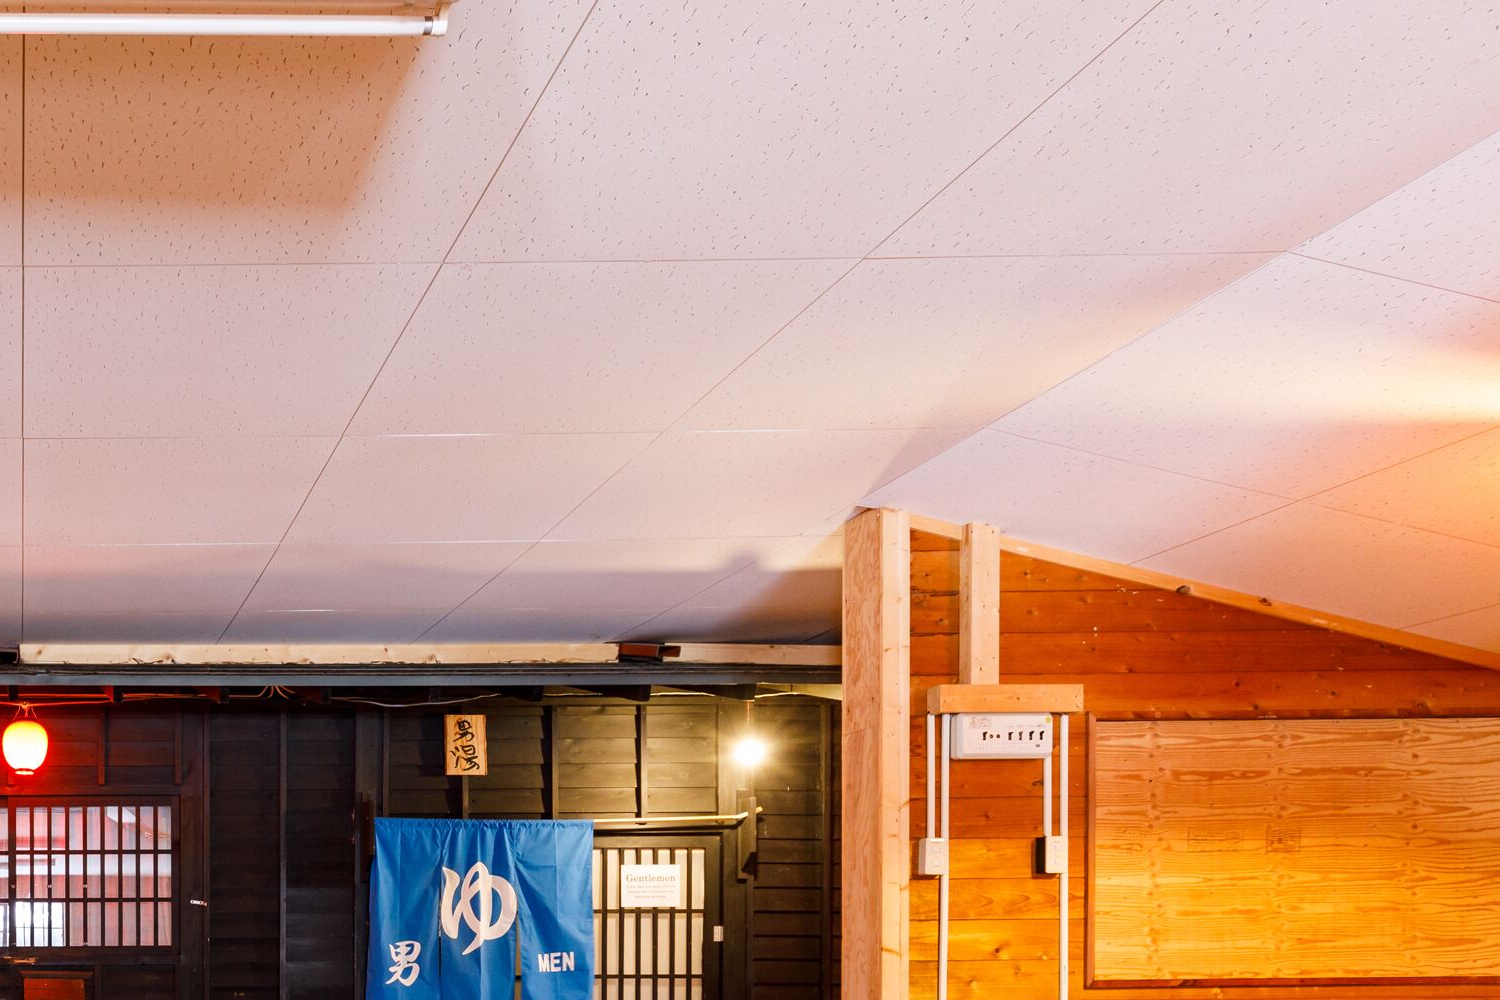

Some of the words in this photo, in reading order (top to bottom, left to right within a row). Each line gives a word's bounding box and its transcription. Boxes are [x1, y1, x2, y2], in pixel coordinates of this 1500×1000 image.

[625, 873, 676, 883] Gentlemen
[441, 861, 518, 955] ゆ
[385, 940, 422, 987] 男
[537, 951, 575, 973] MEN
